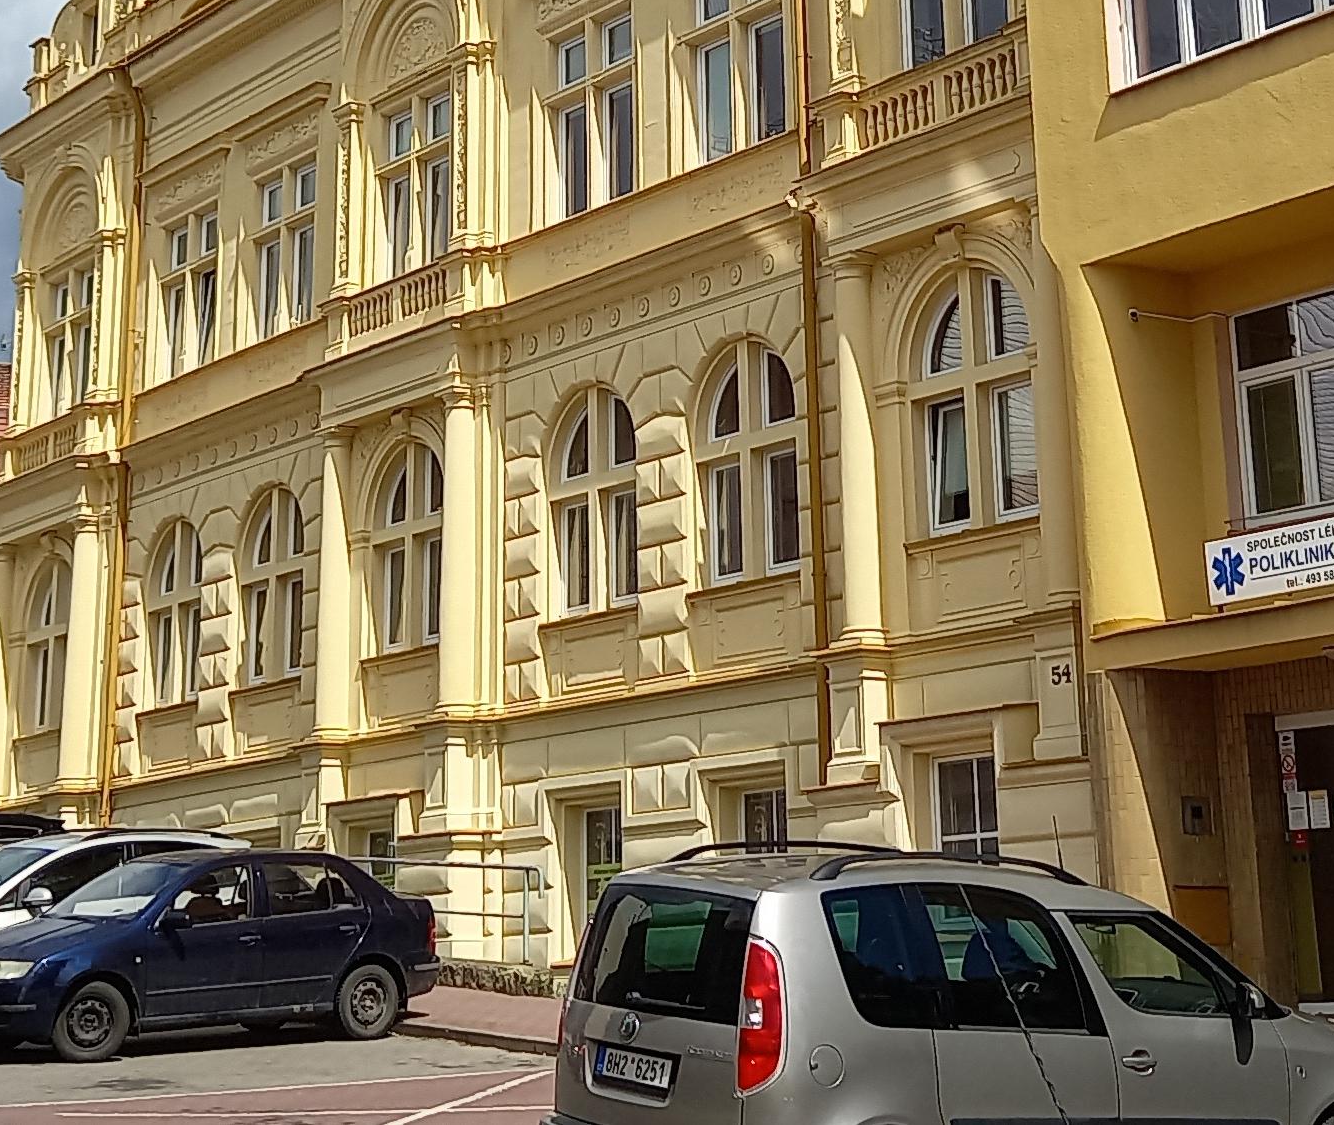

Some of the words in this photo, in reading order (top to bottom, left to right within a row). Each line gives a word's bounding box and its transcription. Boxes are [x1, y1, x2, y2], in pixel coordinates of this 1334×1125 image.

[1246, 528, 1316, 553] SPOLEČNOST
[1305, 571, 1322, 585] 493
[1051, 663, 1072, 686] 54
[605, 1051, 630, 1077] 8H2
[634, 1057, 666, 1086] 6251
